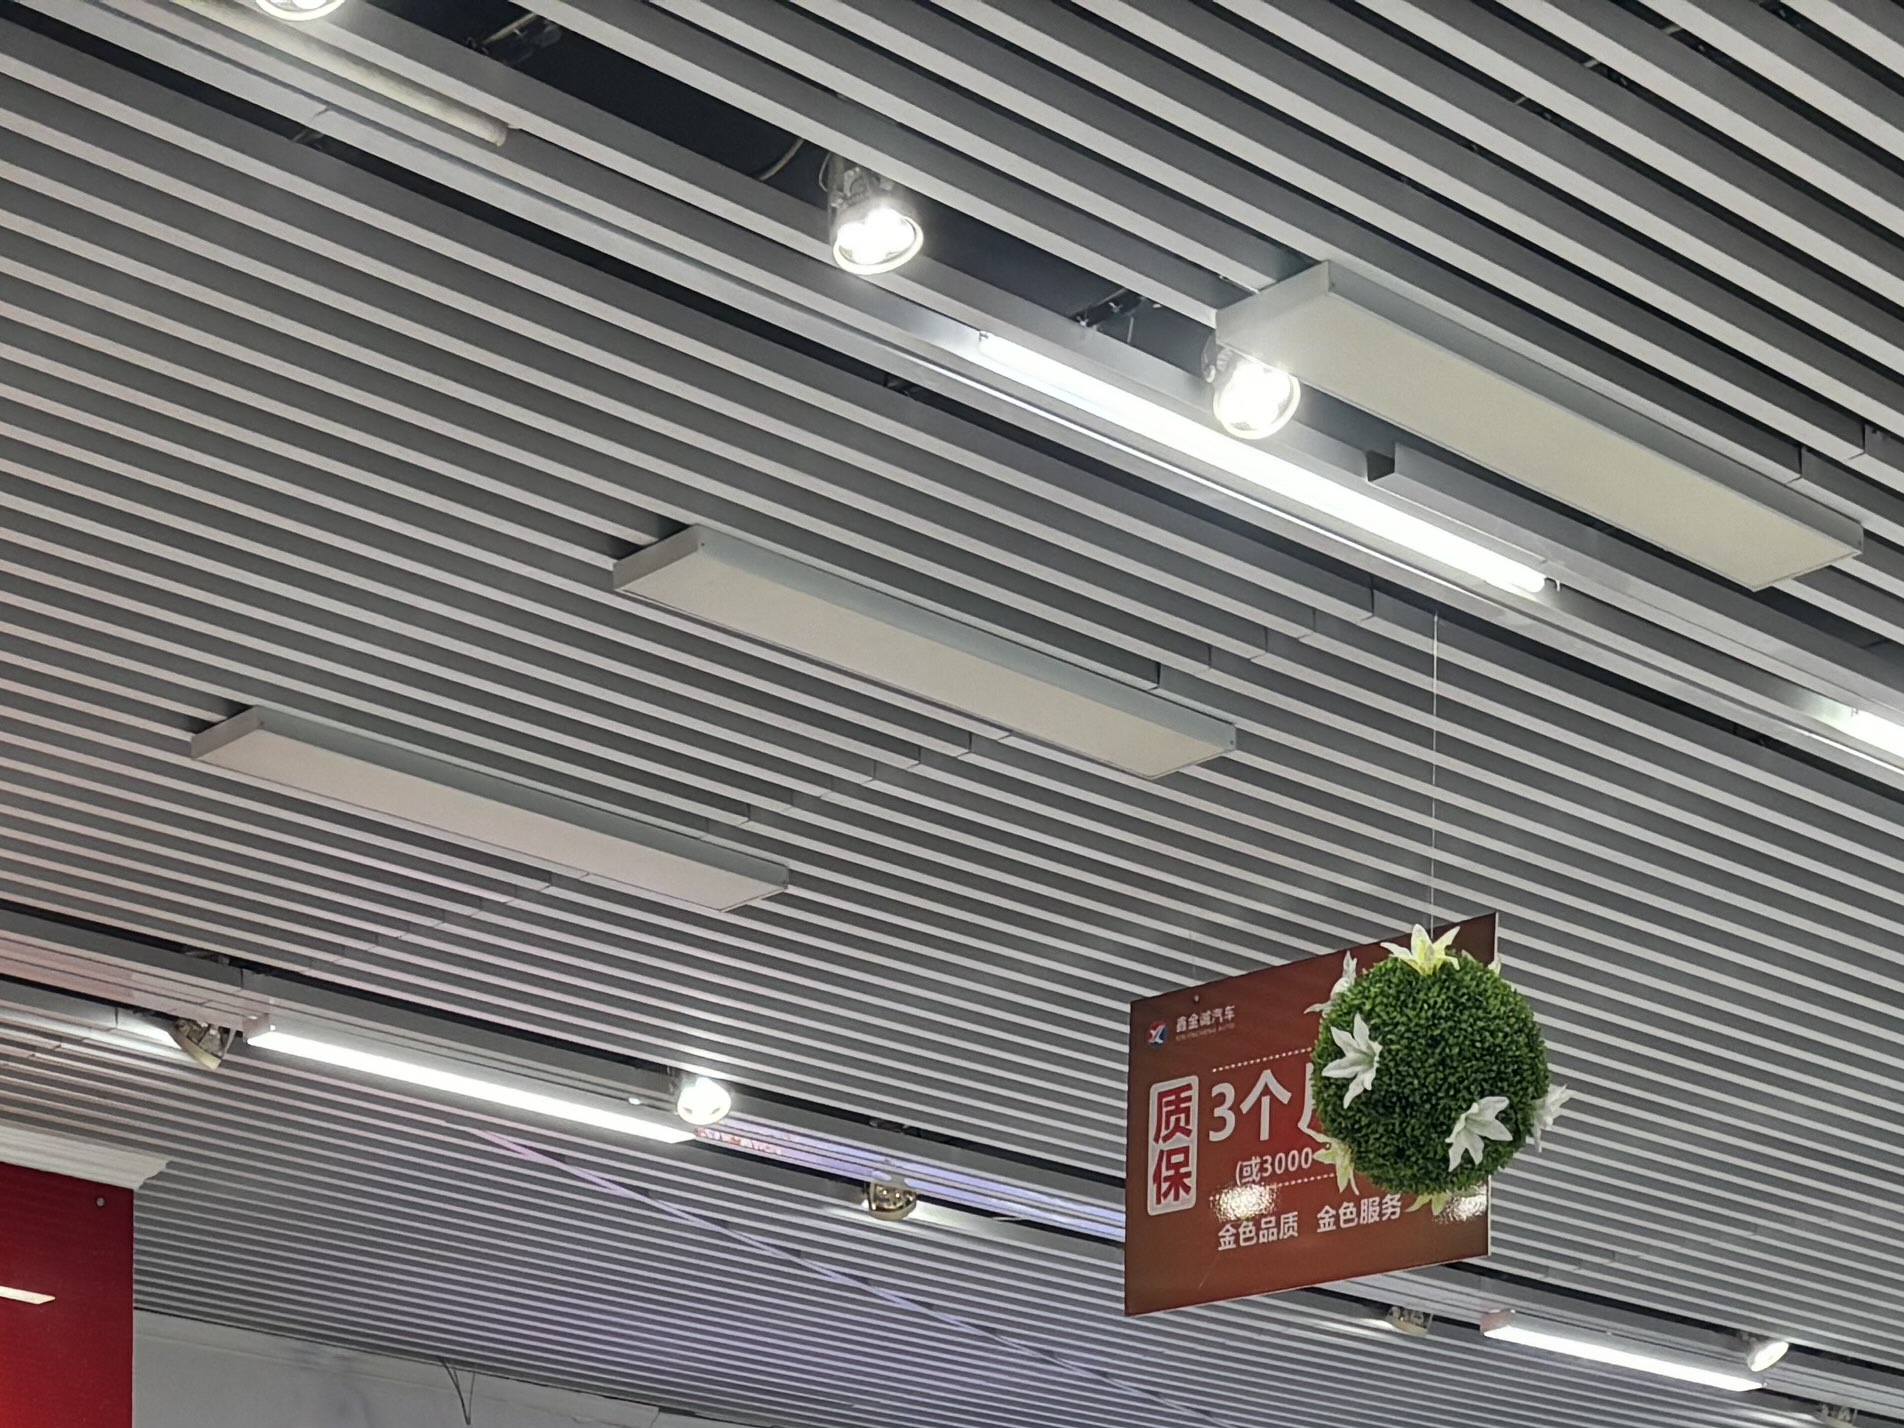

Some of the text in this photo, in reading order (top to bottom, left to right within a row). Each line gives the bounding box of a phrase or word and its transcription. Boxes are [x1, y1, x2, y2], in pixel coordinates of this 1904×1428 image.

[1152, 1082, 1193, 1206] 质保
[1218, 1193, 1403, 1251] 金色品质 金色服务
